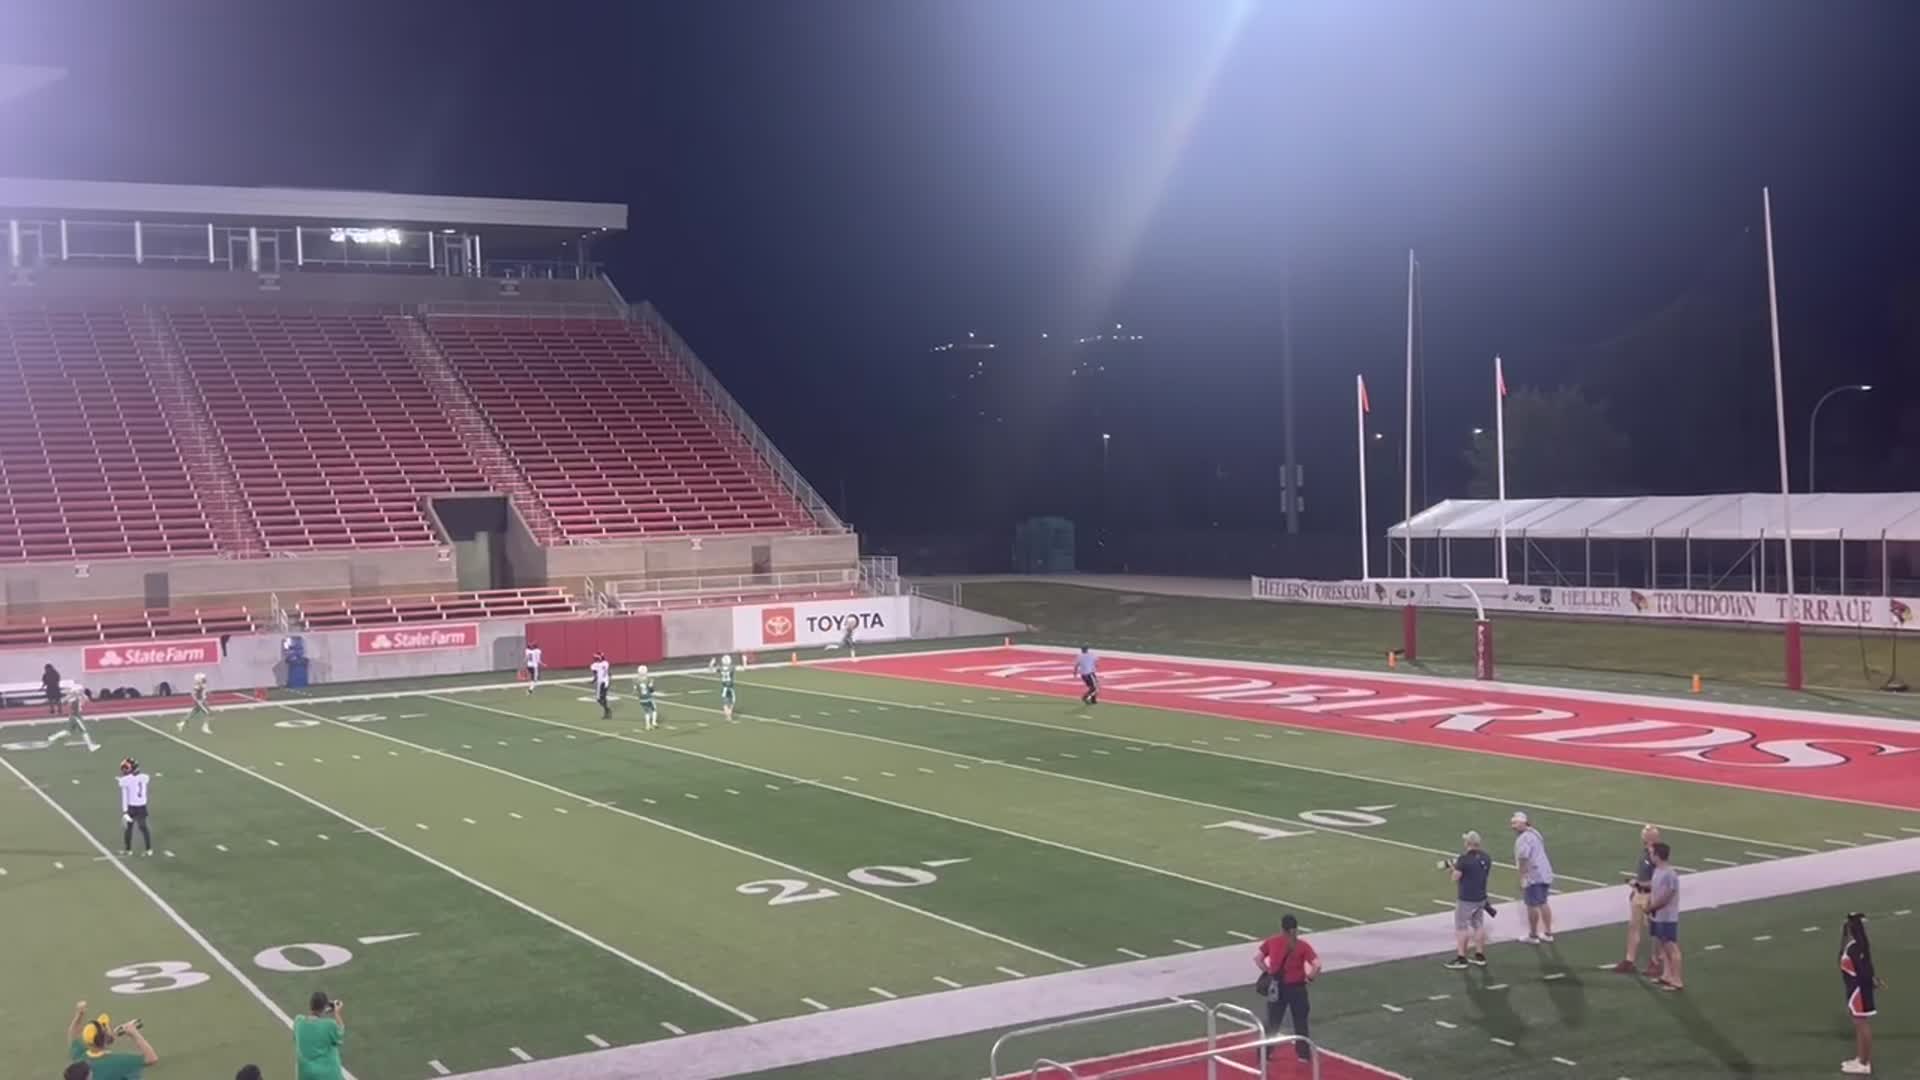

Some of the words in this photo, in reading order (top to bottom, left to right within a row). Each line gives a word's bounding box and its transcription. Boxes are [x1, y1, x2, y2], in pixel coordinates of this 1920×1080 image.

[1561, 591, 1621, 606] HELLER
[1653, 592, 1757, 616] TOUCHDOWN
[1776, 597, 1872, 623] TERRACE
[806, 613, 884, 632] TOYOTA
[941, 660, 1920, 769] REDBIRDS
